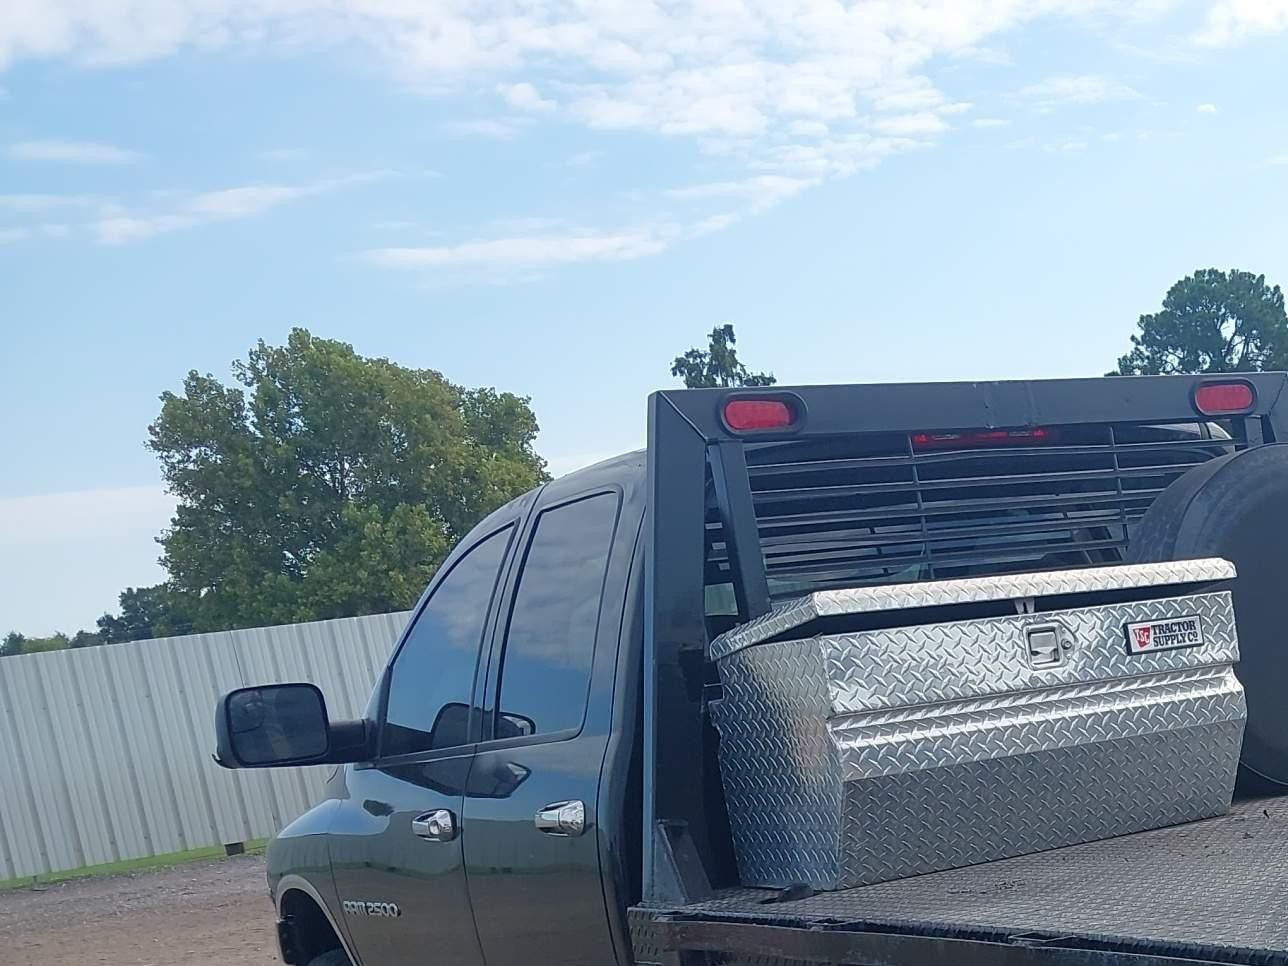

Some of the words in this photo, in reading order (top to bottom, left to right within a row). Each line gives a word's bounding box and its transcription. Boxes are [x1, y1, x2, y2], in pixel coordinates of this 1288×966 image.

[1151, 620, 1197, 636] TRACTOR
[1134, 629, 1150, 643] TSC
[366, 902, 399, 917] 2500
